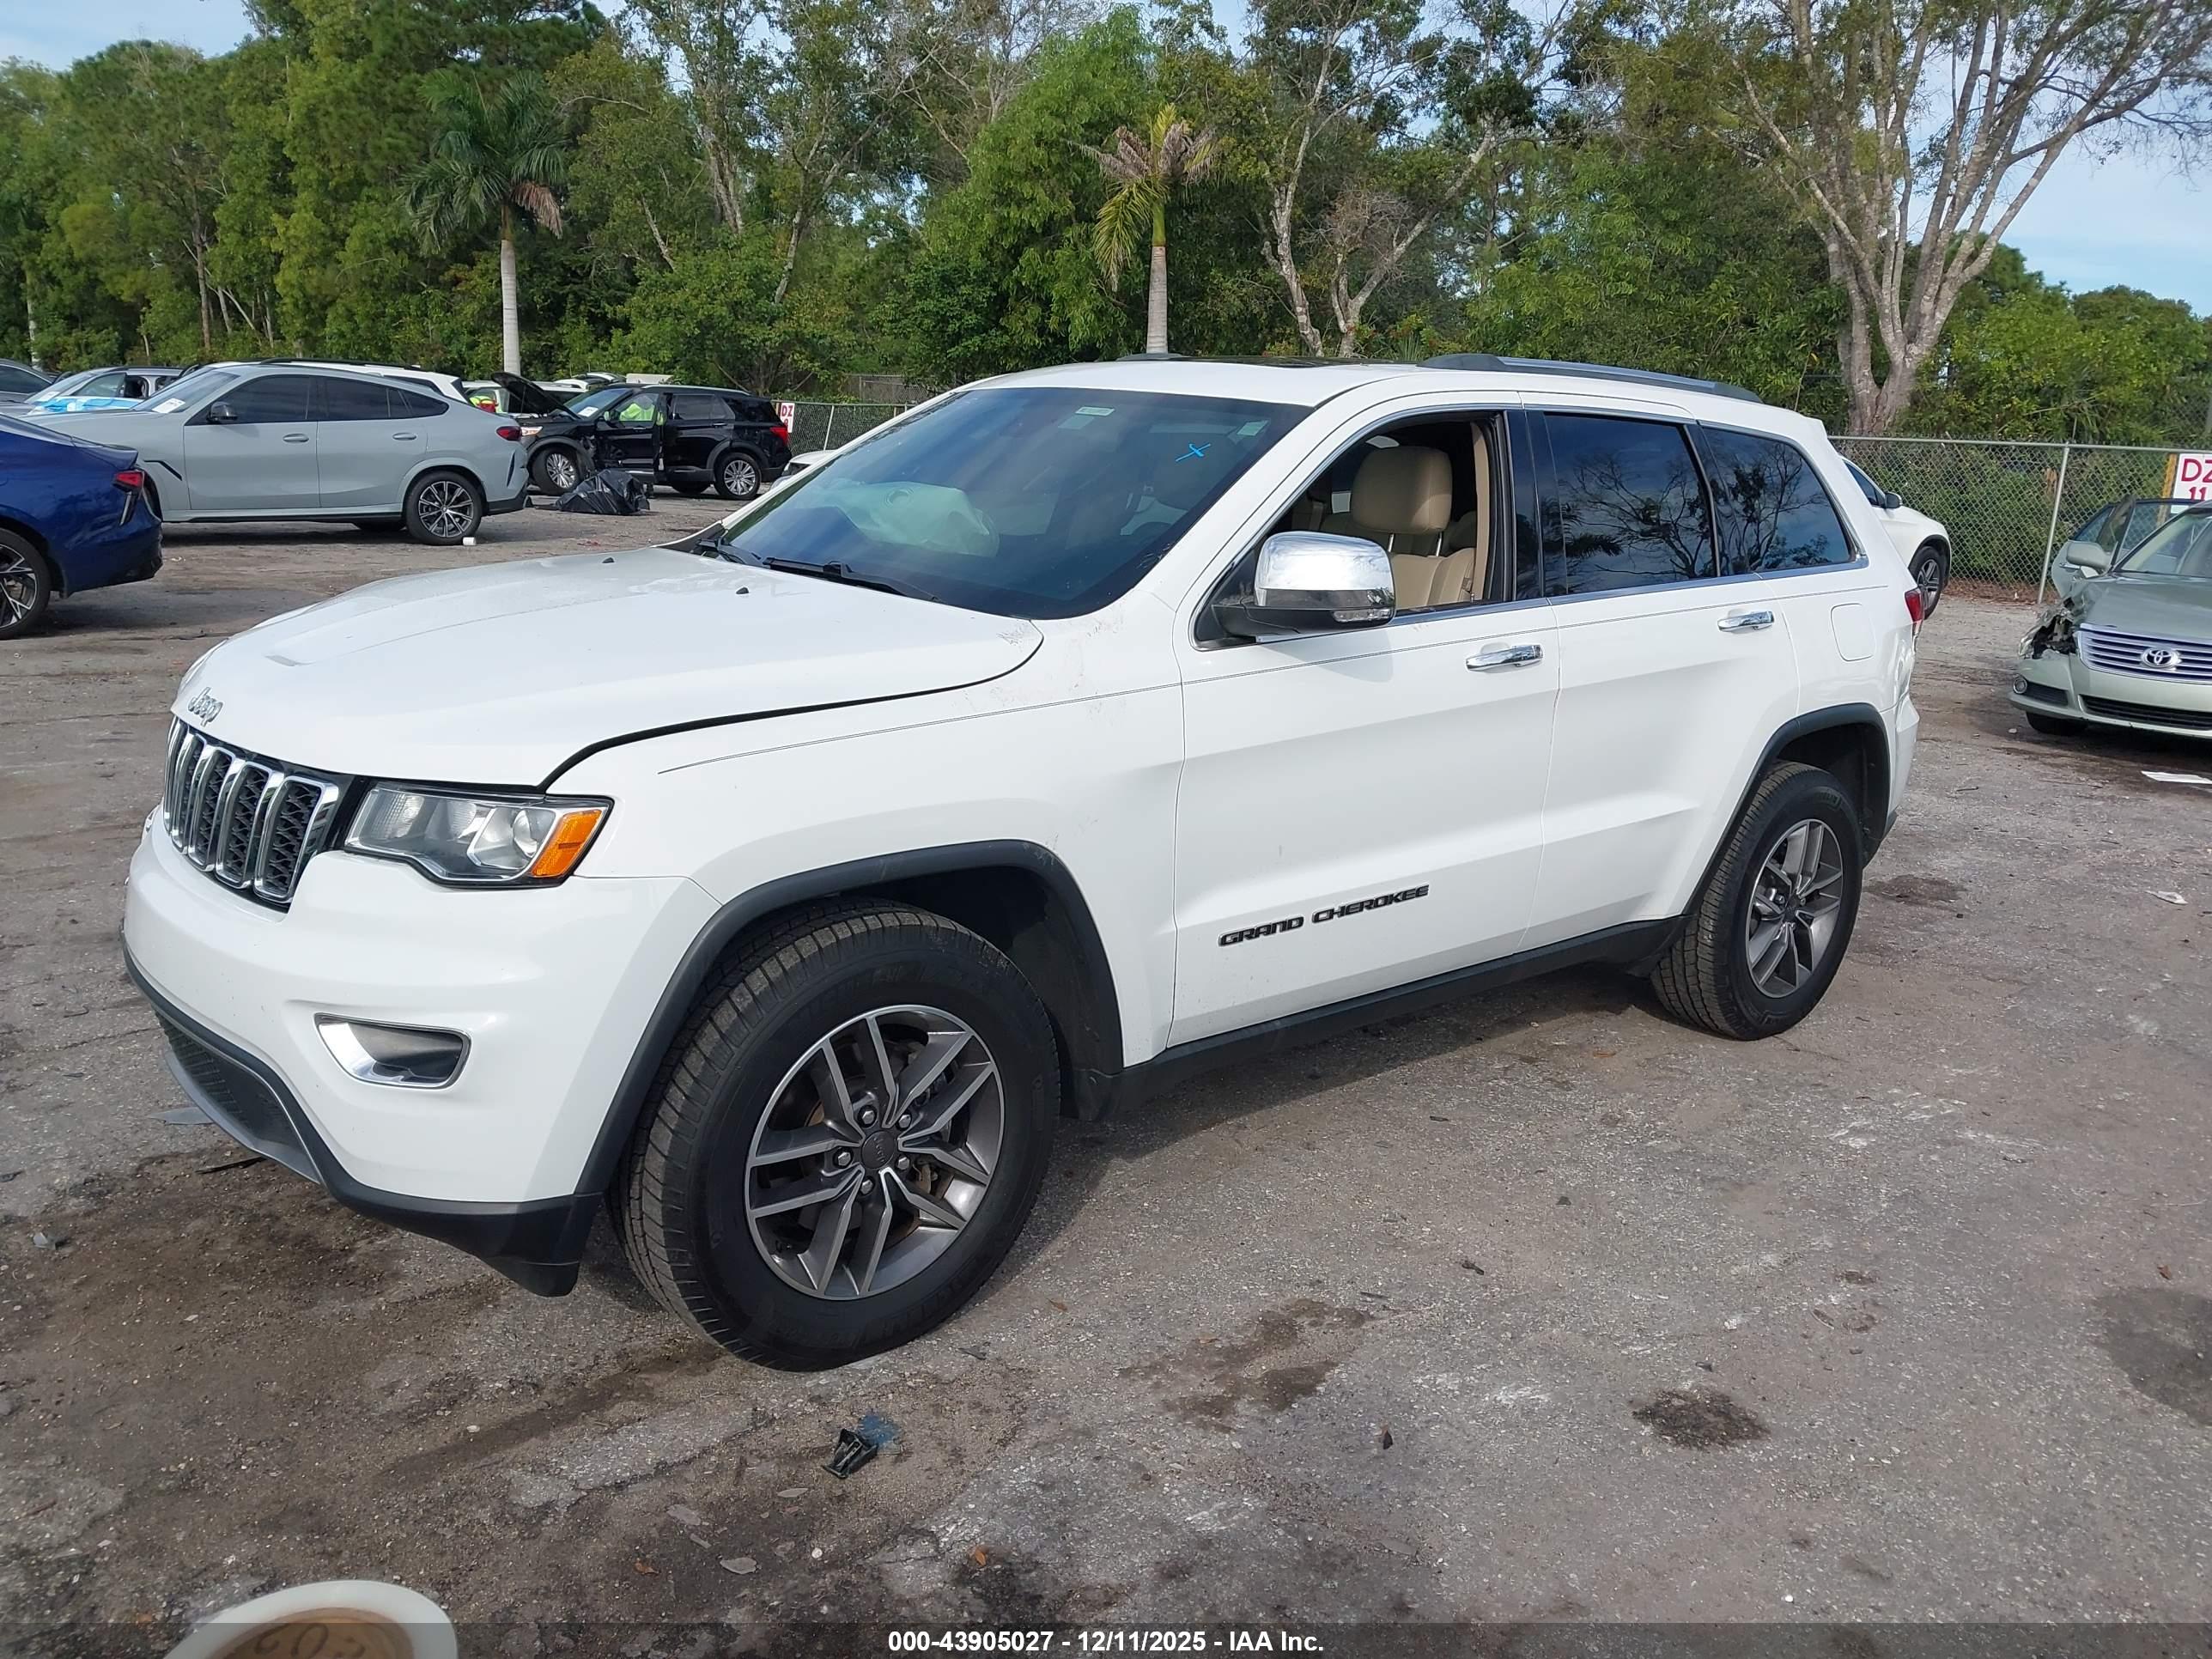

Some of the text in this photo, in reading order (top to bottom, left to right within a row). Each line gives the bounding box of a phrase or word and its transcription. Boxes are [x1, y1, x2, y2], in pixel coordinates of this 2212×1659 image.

[781, 404, 793, 416] DZ
[188, 686, 224, 727] Jeep
[1218, 884, 1430, 947] GRAND CHEROKEE
